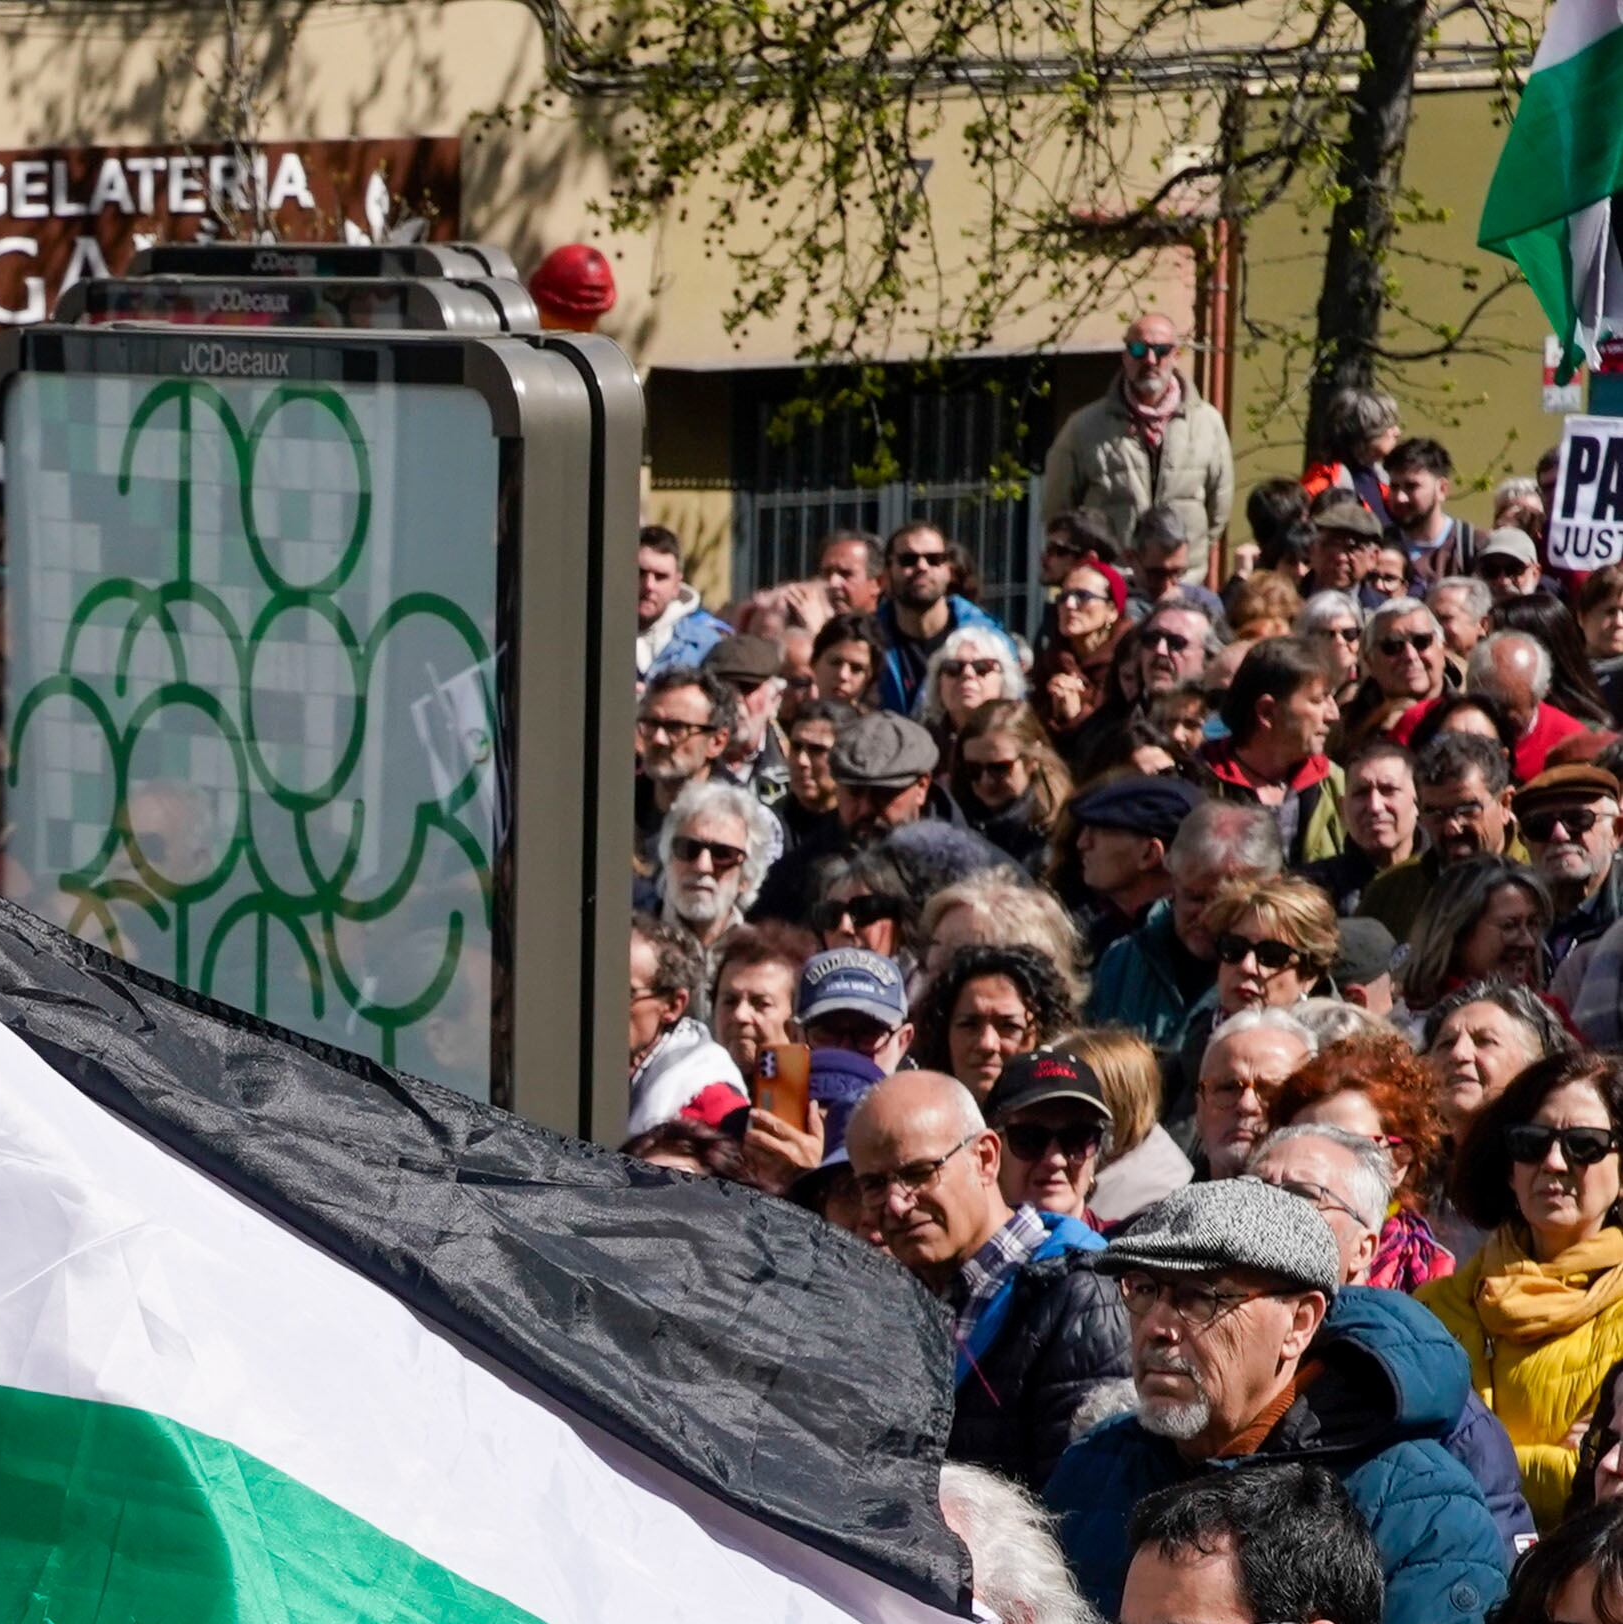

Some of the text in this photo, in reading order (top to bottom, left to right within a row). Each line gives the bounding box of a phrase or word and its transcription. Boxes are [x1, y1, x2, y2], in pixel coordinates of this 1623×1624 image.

[209, 287, 290, 312] JCDecaux
[181, 343, 290, 375] JCDecaux
[1553, 526, 1623, 559] JUS
